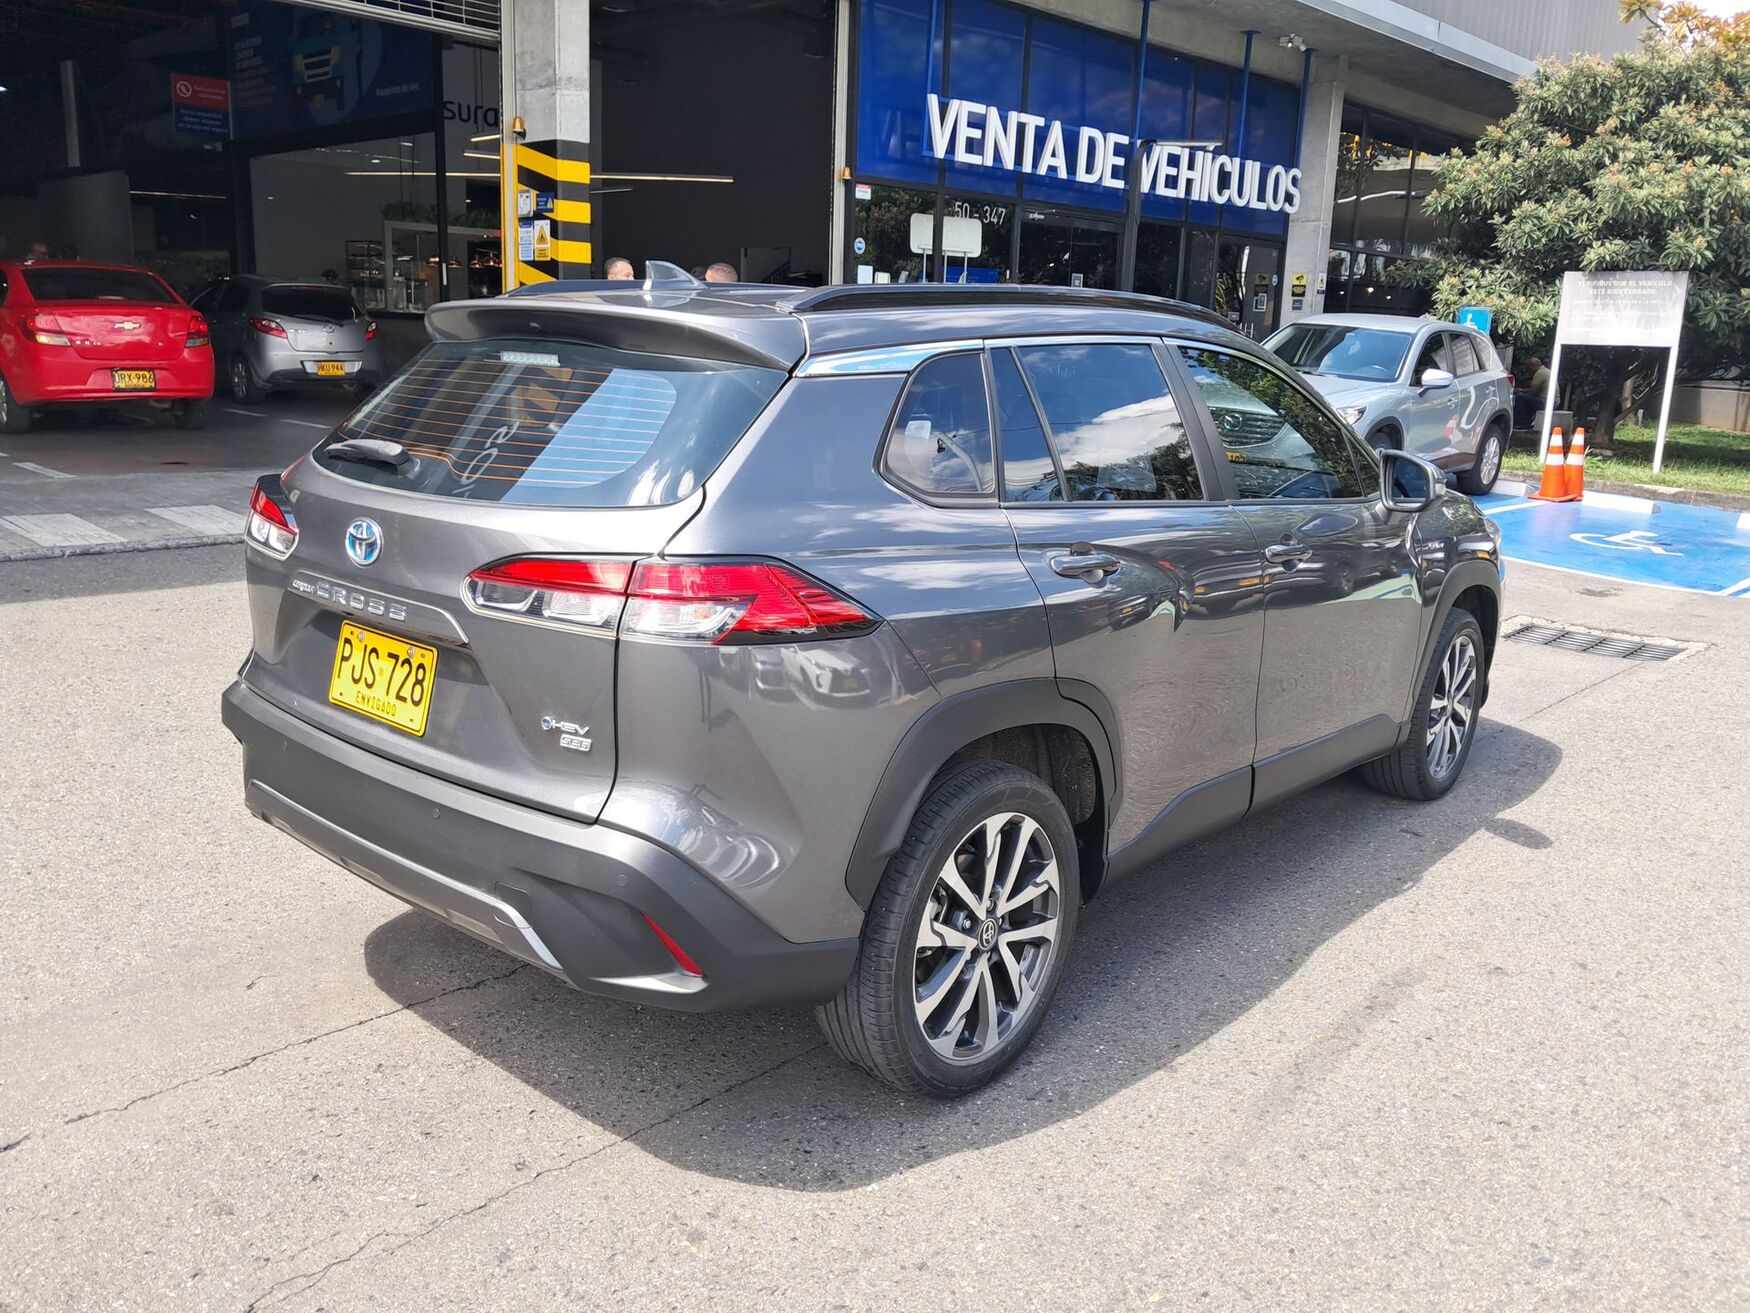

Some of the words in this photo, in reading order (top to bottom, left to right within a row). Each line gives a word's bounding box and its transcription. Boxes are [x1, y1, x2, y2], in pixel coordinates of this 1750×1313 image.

[442, 101, 499, 127] sura
[927, 93, 1068, 179] VENTA
[1076, 126, 1130, 189] DE
[955, 202, 970, 218] 50
[983, 206, 1006, 225] 347
[317, 580, 407, 622] CROSS
[355, 690, 398, 718] ENVIGADO
[552, 719, 590, 735] HEV
